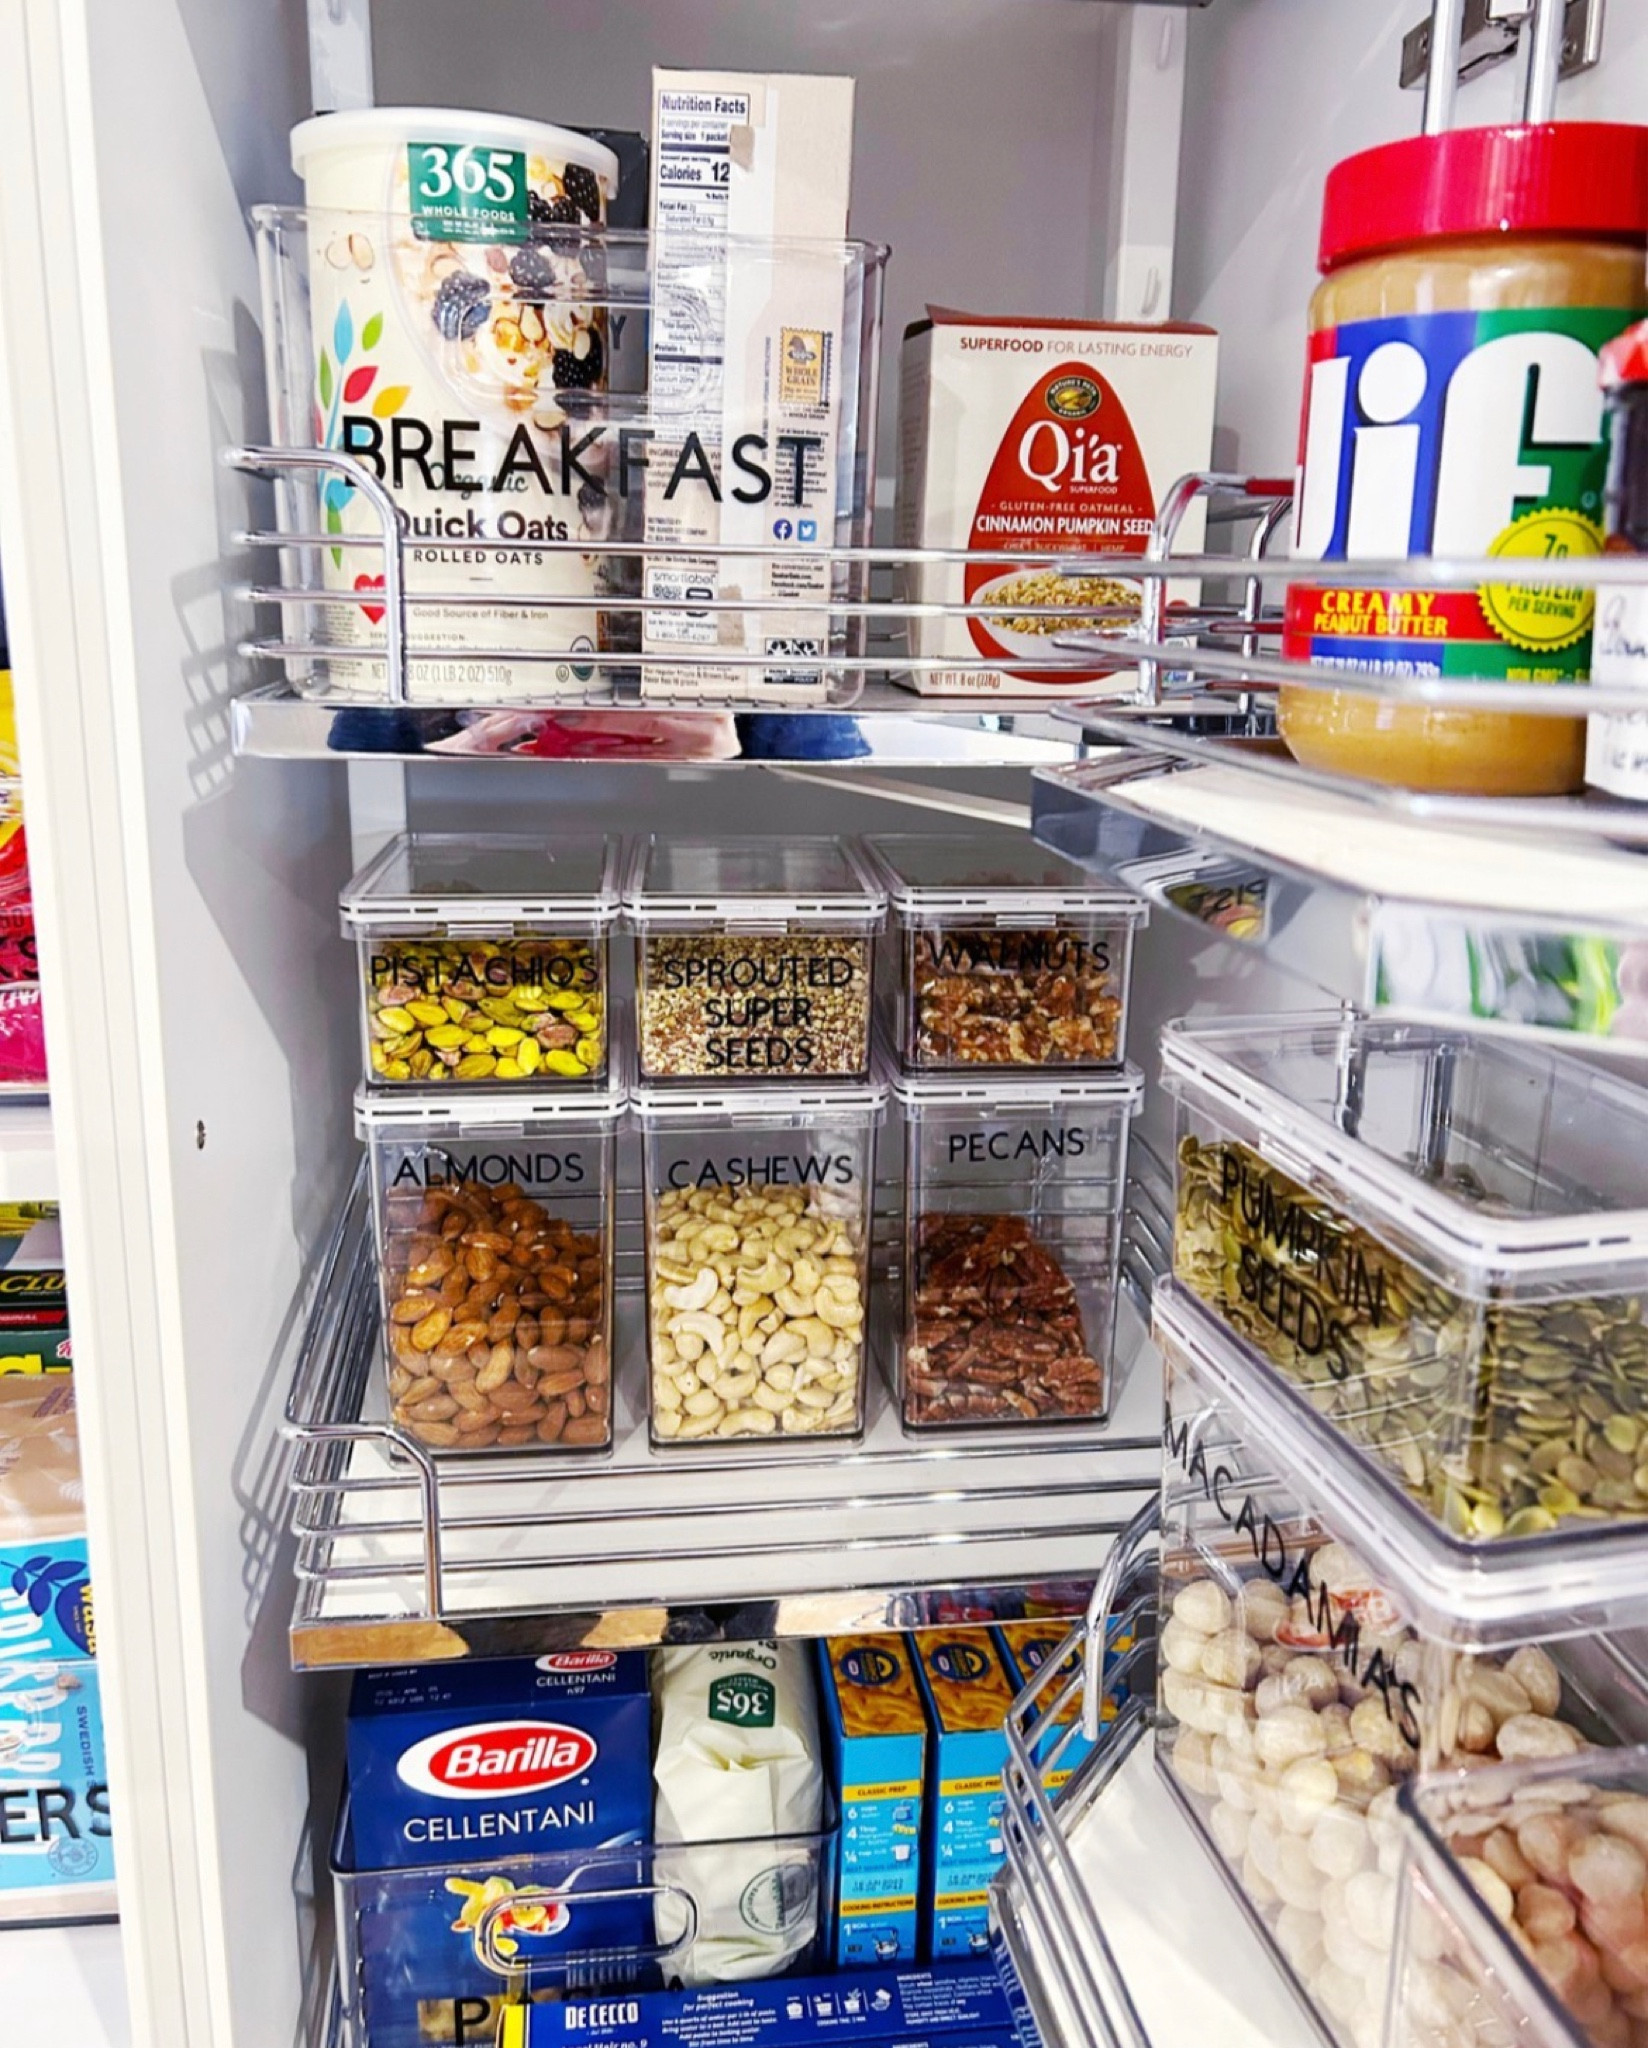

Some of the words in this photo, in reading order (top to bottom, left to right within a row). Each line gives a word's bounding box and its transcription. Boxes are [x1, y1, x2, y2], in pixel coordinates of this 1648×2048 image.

[662, 95, 711, 112] Nutrition
[715, 97, 746, 114] Facts
[419, 142, 516, 204] 365
[660, 164, 702, 181] Calories
[711, 161, 731, 182] 12
[421, 205, 467, 217] WHOLE
[473, 207, 515, 222] FOODS
[960, 336, 1044, 353] SUPERFOOD
[1047, 340, 1075, 354] FOR
[1078, 341, 1136, 356] LASTING
[1140, 343, 1193, 359] ENERGY
[786, 366, 818, 376] WHOLE
[787, 376, 816, 385] GRAIN
[1289, 331, 1603, 559] Jif
[342, 415, 822, 505] BREAKFAST
[1069, 485, 1118, 495] SUPERFOOD
[1000, 500, 1076, 513] GLUTEN-FREE
[1080, 503, 1135, 514] OATMEAL
[497, 509, 568, 541] Oats
[976, 514, 1054, 533] CINNAMON
[1057, 516, 1120, 535] PUMPKIN
[413, 549, 487, 563] ROLLED
[495, 550, 544, 566] OATS
[412, 607, 441, 618] Good
[443, 607, 478, 618] Source
[481, 608, 491, 618] of
[494, 609, 518, 619] Fiber
[521, 610, 528, 619] &
[530, 610, 548, 619] Iron
[1320, 589, 1436, 616] CREAMY
[1508, 596, 1530, 612] PER
[1532, 600, 1577, 619] SERVING
[1313, 612, 1373, 635] PEANUT
[1375, 614, 1449, 637] BUTTER
[416, 664, 429, 681] OZ
[457, 664, 465, 681] 2
[930, 671, 943, 686] NET
[929, 941, 1110, 974] WALNUTS
[370, 953, 599, 988] PISTACHIOS
[663, 956, 854, 989] SPROUTED
[704, 997, 813, 1029] SUPER
[704, 1036, 815, 1069] SEEDS
[948, 1127, 1086, 1164] PECANS
[392, 1152, 585, 1187] ALMONDS
[667, 1156, 854, 1190] CASHEWS
[1221, 1151, 1385, 1329] PUMPKIN
[1237, 1244, 1352, 1381] SEEDS
[554, 1652, 611, 1666] Barilla
[708, 1648, 777, 1671] Organic
[536, 1672, 617, 1688] CELLENTANI
[715, 1688, 769, 1719] 365
[75, 1705, 97, 1779] SWEDISH
[444, 1735, 582, 1780] Barilla
[857, 1786, 887, 1796] CLASSIC
[888, 1785, 907, 1793] PREP
[954, 1781, 983, 1791] CLASSIC
[847, 1807, 858, 1820] 6
[944, 1801, 955, 1814] 6
[403, 1799, 595, 1843] CELLENTANI
[943, 1820, 954, 1835] 4
[846, 1826, 858, 1840] 4
[842, 1903, 872, 1912] COOKING
[872, 1899, 915, 1909] INSTRUCTIONS
[937, 1896, 966, 1905] COOKING
[843, 1922, 852, 1937] 1
[938, 1915, 946, 1930] 1
[682, 2003, 695, 2014] for
[696, 2000, 723, 2012] perfect
[724, 1998, 755, 2008] cooking
[697, 1991, 739, 2002] Suggestion
[589, 2002, 639, 2029] CECCO
